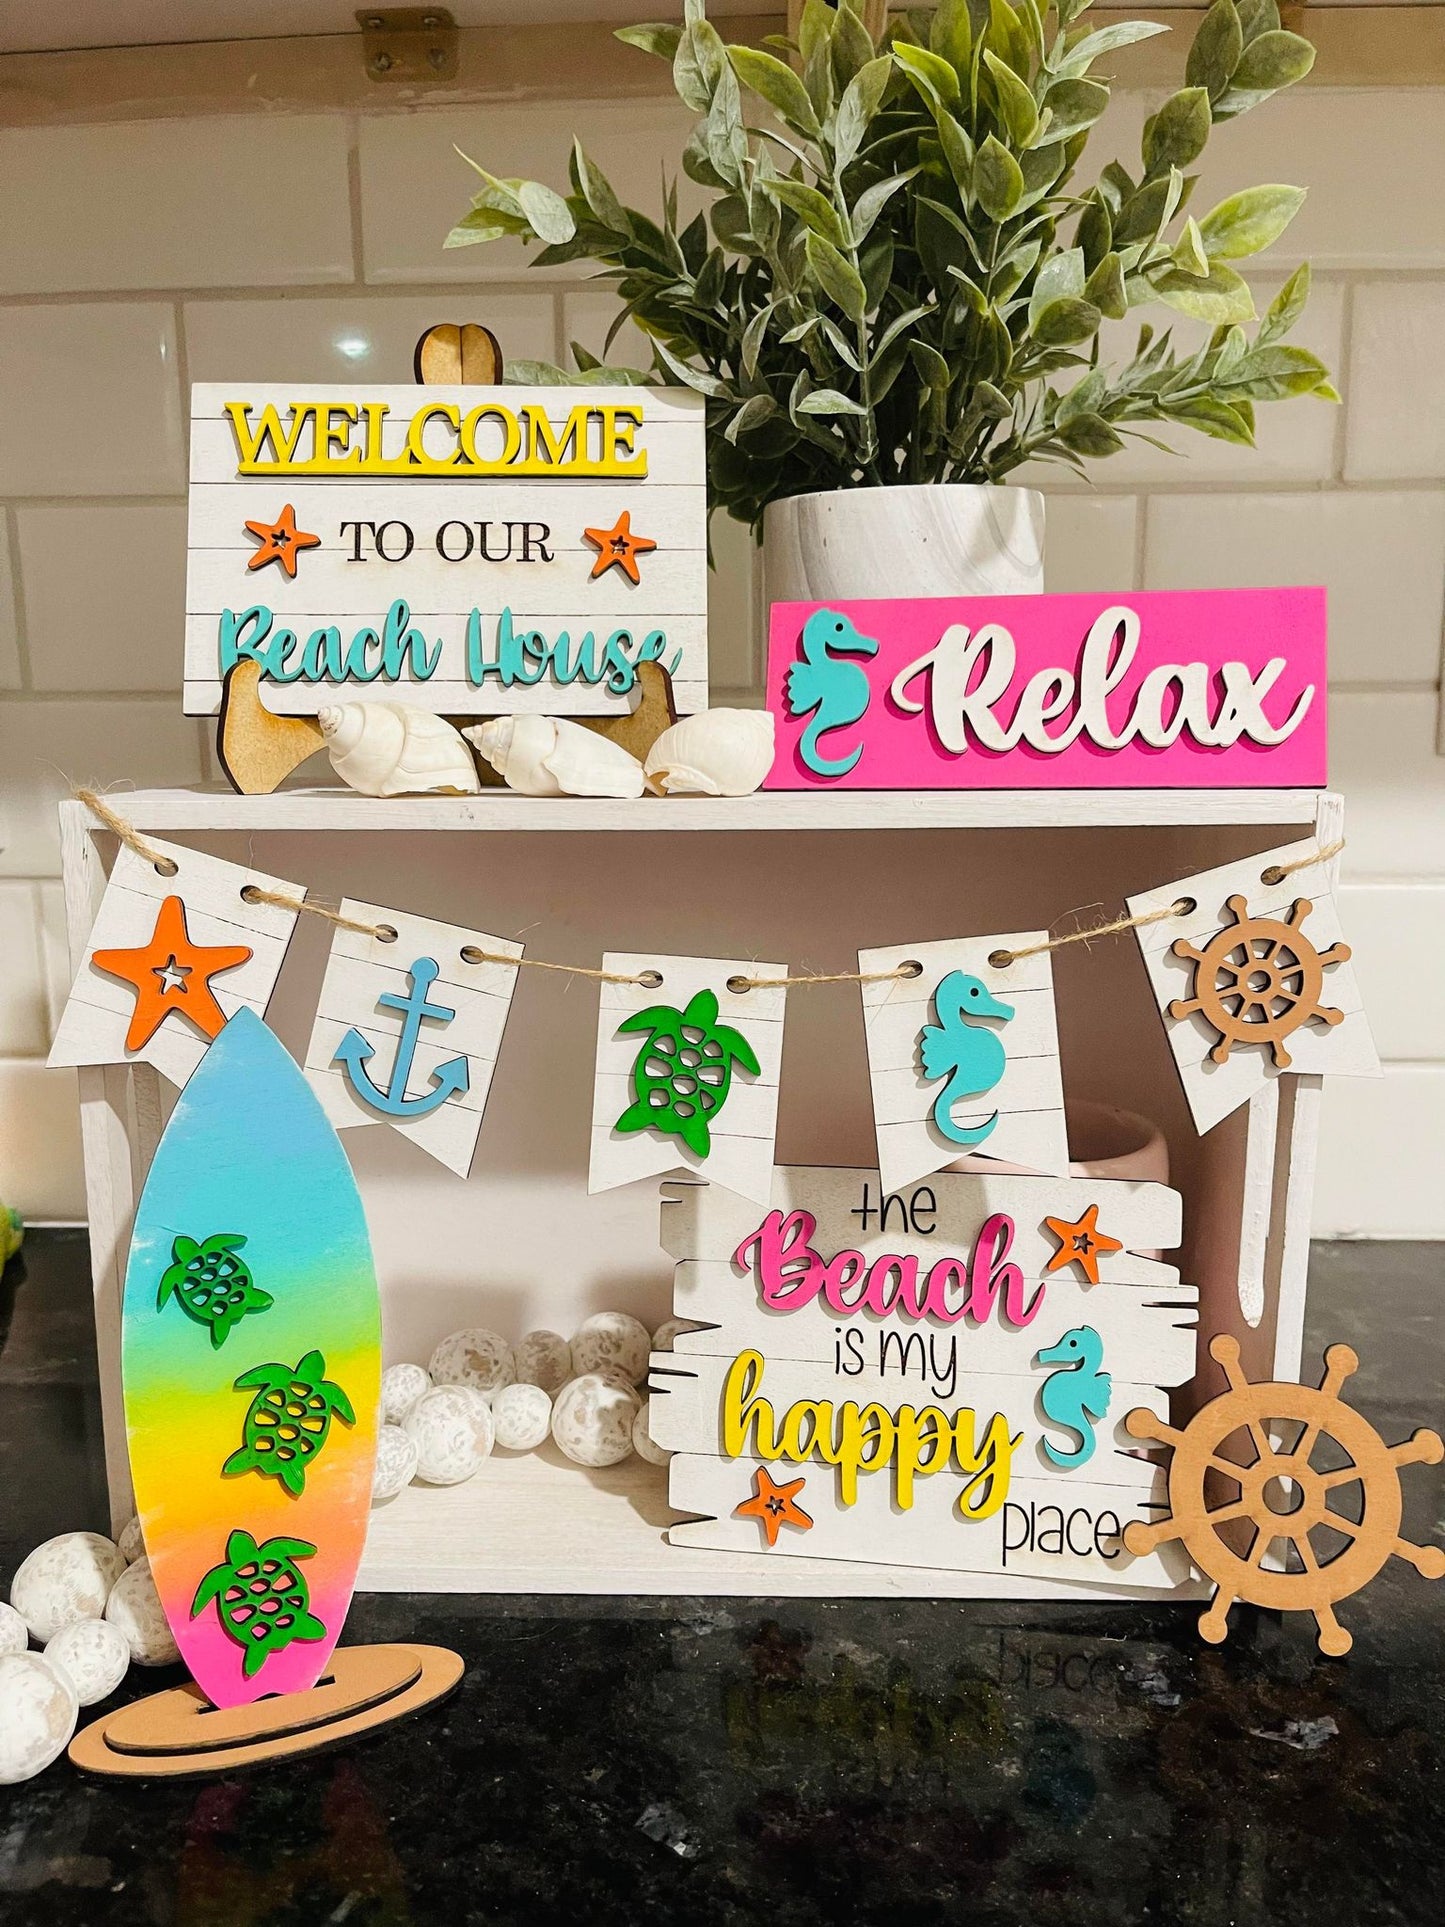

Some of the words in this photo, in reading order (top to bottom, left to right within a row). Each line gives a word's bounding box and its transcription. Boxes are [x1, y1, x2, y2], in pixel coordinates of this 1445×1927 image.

[224, 402, 648, 477] WELCOME
[340, 520, 415, 563] TO
[435, 520, 555, 563] OUR
[219, 598, 443, 684] Beach
[467, 605, 683, 695] House
[890, 605, 1316, 754] Relax
[850, 1182, 937, 1235] the
[736, 1208, 1046, 1327] Beach
[834, 1327, 865, 1376] is
[879, 1332, 957, 1399] my
[723, 1348, 1024, 1520] happy
[1001, 1501, 1121, 1567] place
